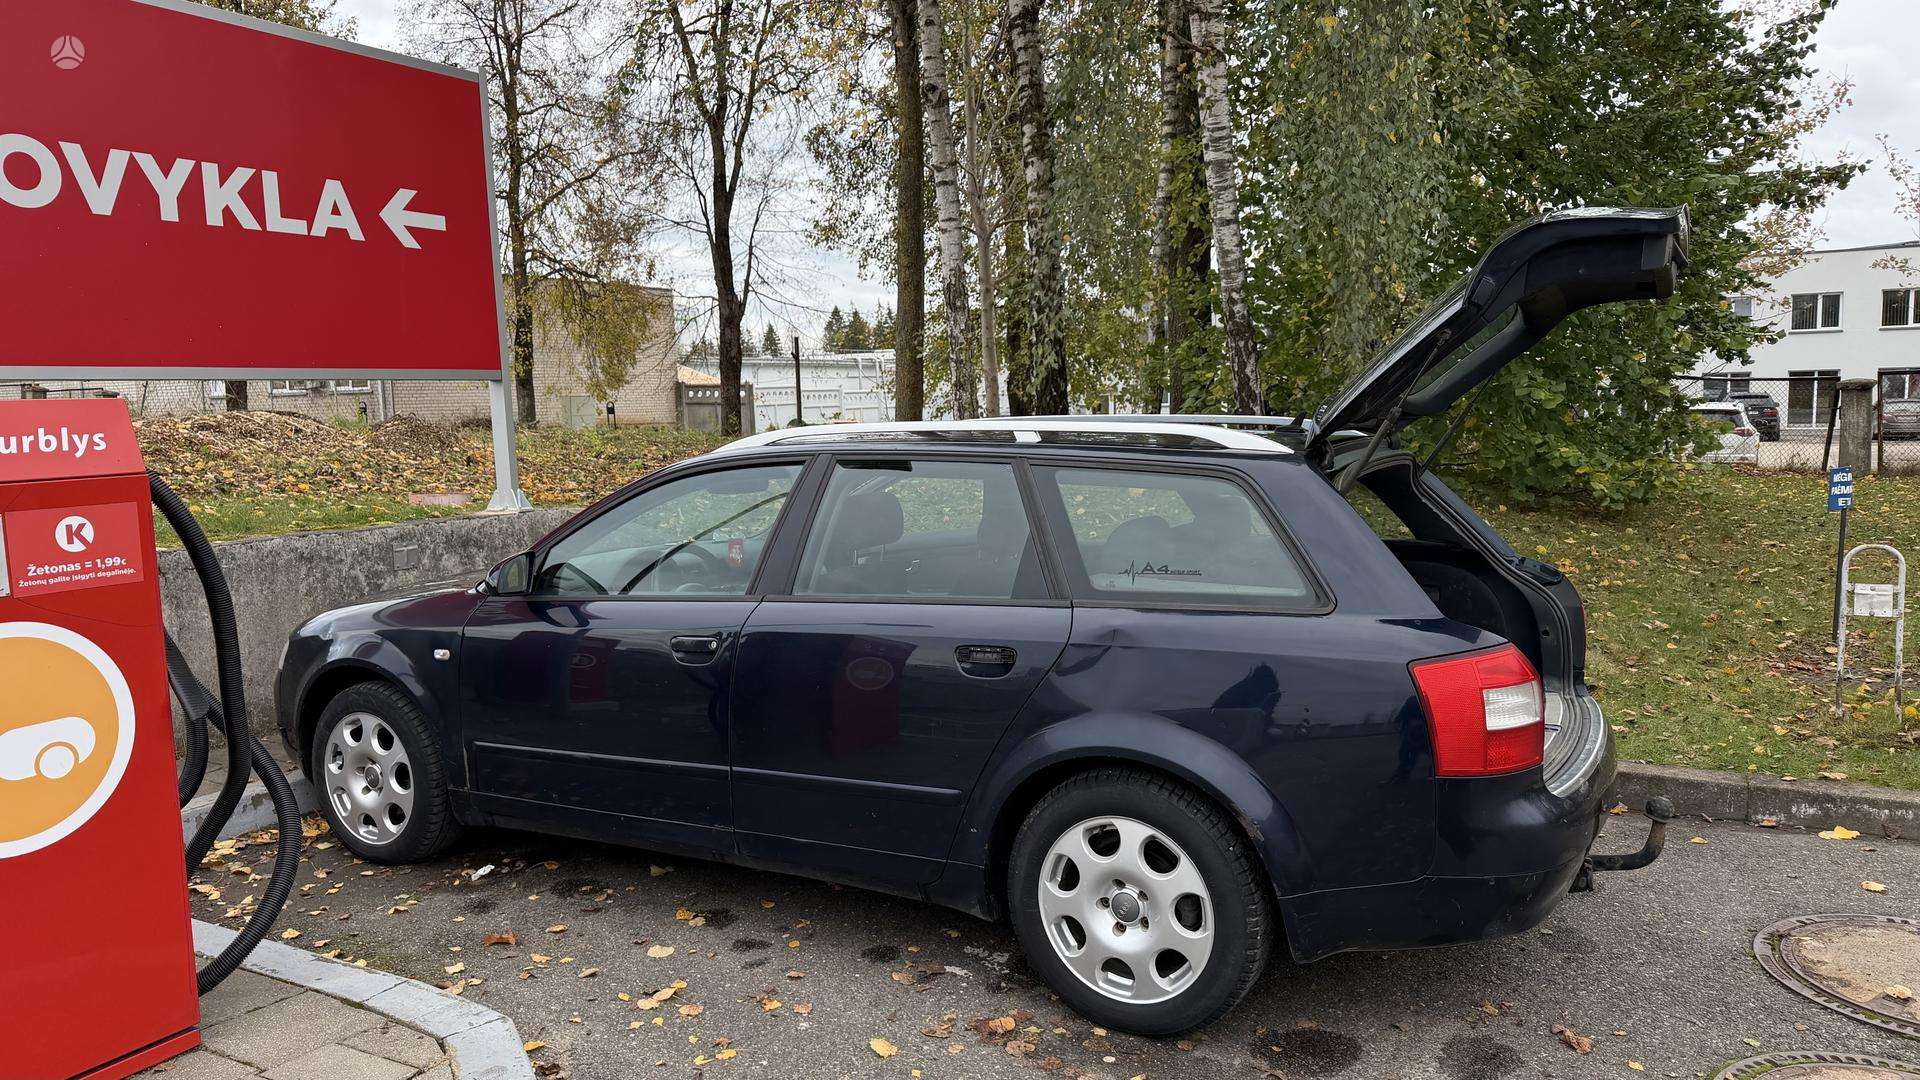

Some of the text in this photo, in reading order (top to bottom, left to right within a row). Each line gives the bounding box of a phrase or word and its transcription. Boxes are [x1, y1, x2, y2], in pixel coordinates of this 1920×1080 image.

[0, 133, 366, 241] OVYKLA
[0, 427, 107, 458] urblys
[27, 563, 82, 576] Žetonas
[1141, 561, 1169, 574] A4
[18, 579, 47, 588] Žetonų
[48, 575, 70, 585] galite
